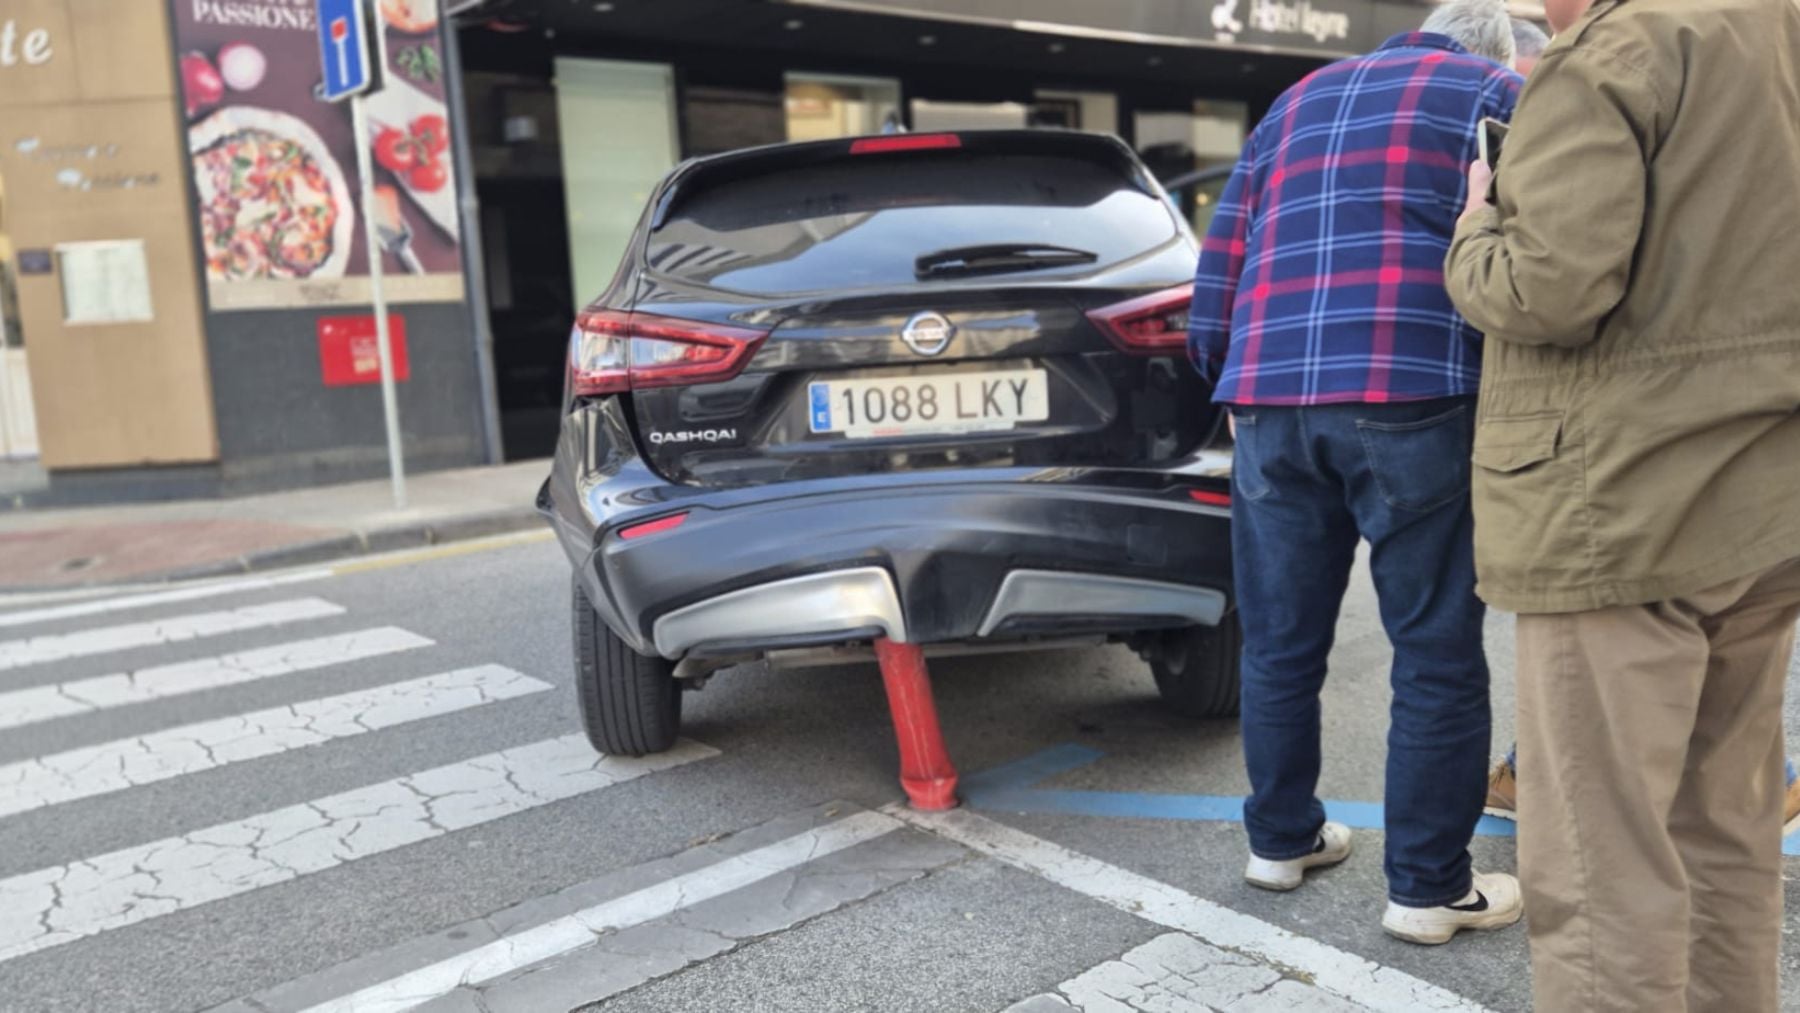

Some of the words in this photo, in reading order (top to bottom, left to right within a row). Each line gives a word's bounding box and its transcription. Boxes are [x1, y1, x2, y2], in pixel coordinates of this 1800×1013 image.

[193, 0, 316, 30] PASSIONE
[842, 383, 939, 426] 1088
[955, 377, 1029, 420] LKY
[649, 428, 737, 445] QASHQAI
